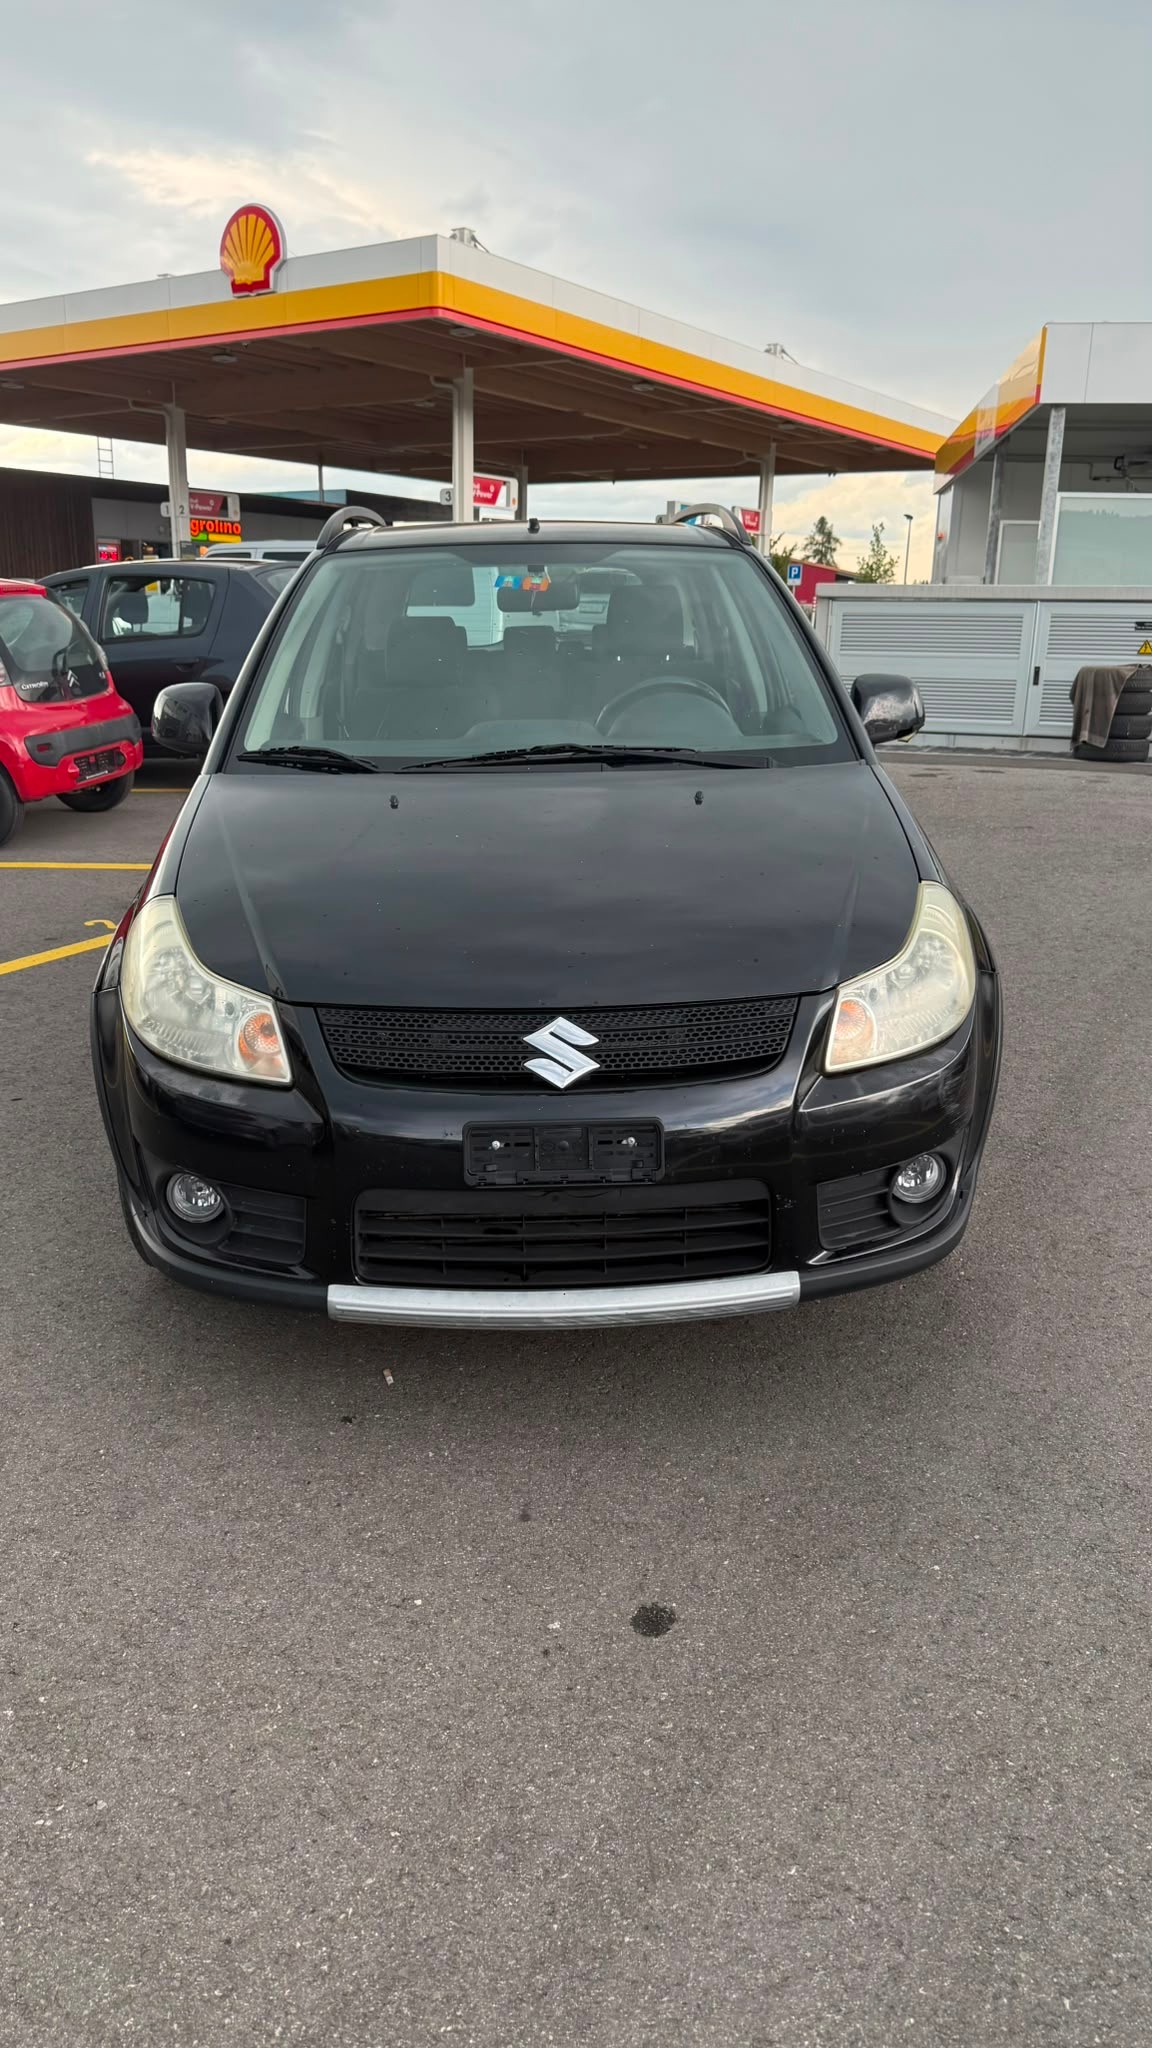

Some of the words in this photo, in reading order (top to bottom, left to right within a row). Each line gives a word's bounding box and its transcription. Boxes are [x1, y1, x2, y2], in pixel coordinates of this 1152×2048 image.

[445, 491, 452, 502] 3
[179, 505, 185, 515] 2
[190, 518, 242, 536] grolino
[791, 567, 799, 578] P
